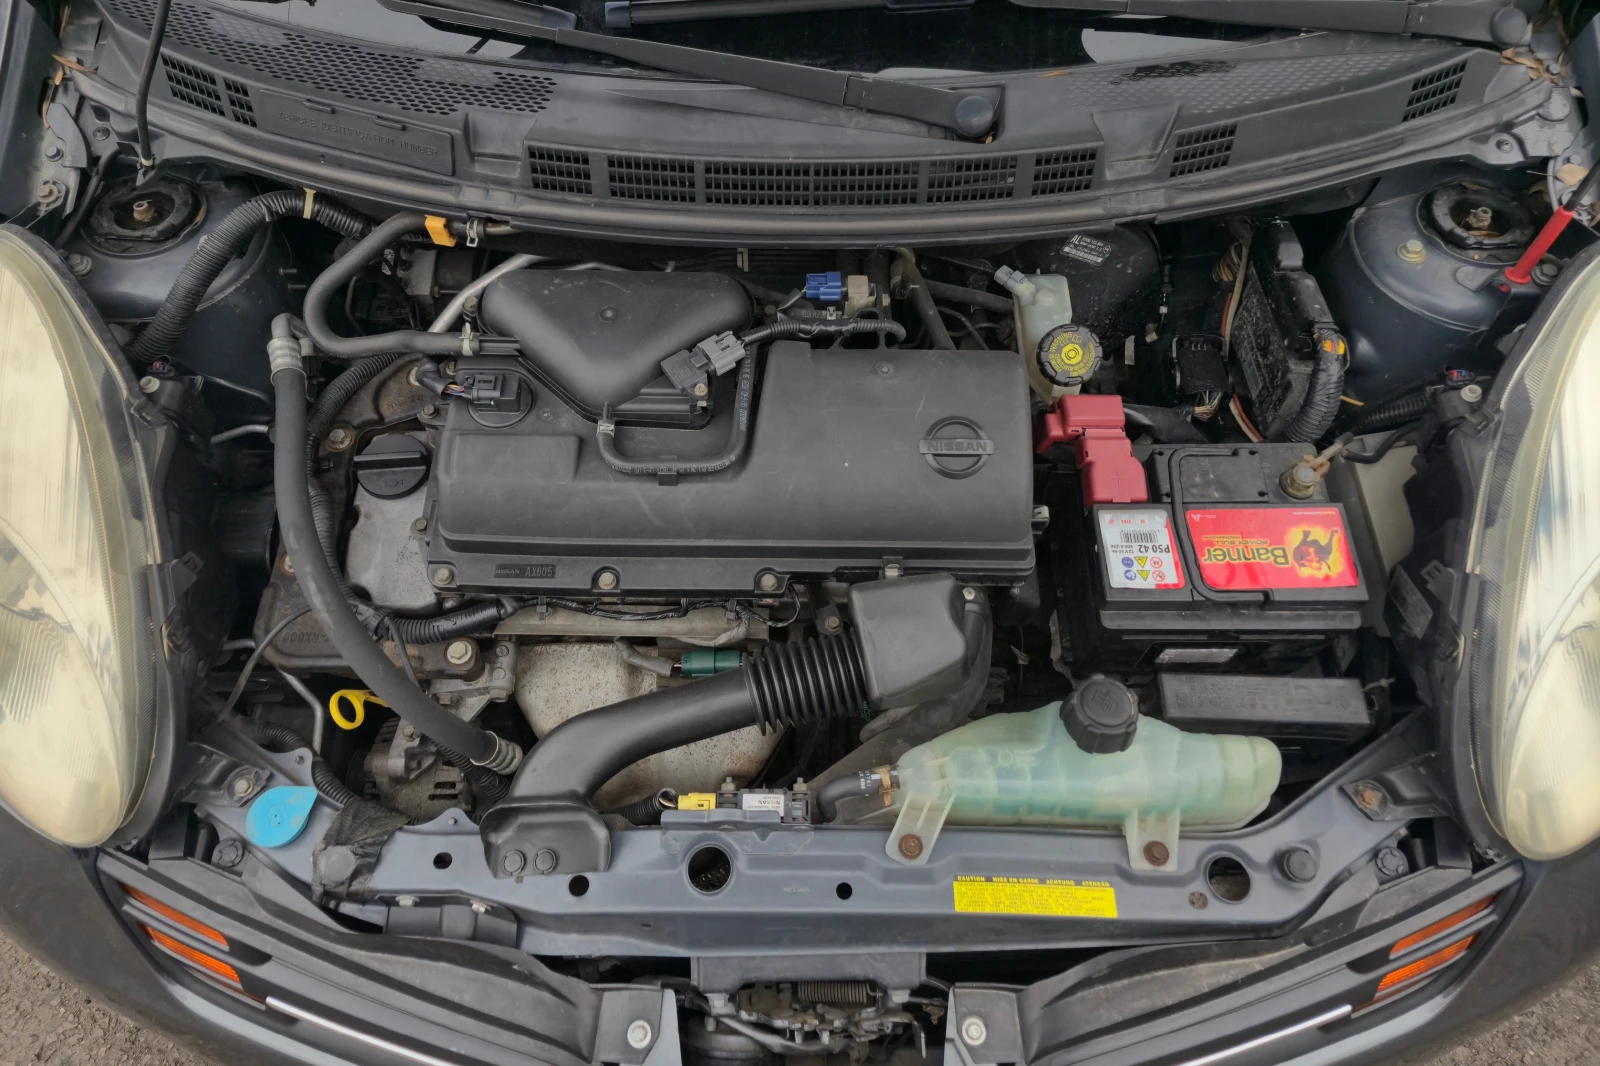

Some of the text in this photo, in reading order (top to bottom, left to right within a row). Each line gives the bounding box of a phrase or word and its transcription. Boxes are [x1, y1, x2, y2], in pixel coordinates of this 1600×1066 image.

[277, 110, 438, 156] VEHICLE IDENTIFICATION NUMBER
[927, 441, 988, 452] NISSAN
[1151, 544, 1171, 554] P50
[1203, 546, 1290, 566] Banner
[524, 566, 553, 577] AX605
[1046, 878, 1075, 886] ACHTUNG
